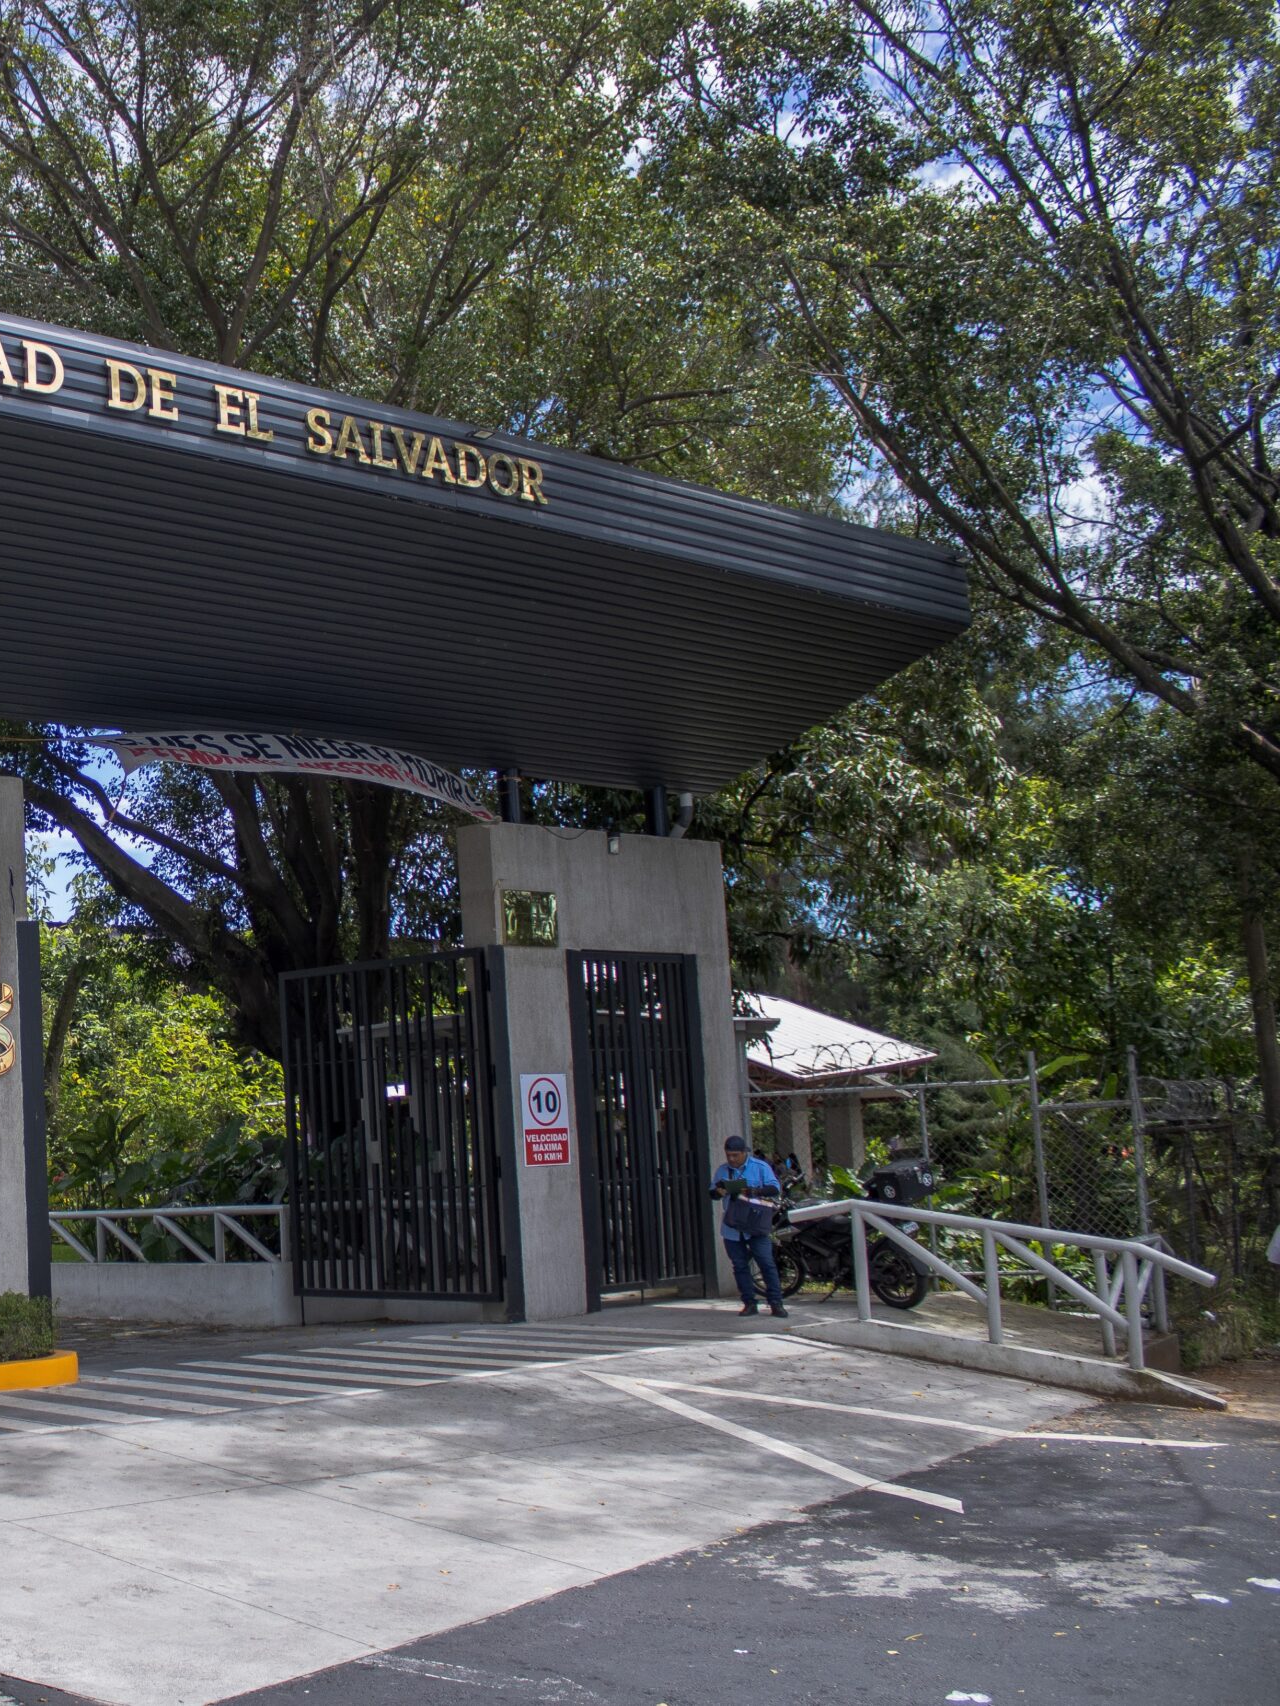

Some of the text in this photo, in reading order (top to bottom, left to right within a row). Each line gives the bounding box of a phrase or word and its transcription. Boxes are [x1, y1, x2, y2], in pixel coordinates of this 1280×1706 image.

[105, 359, 179, 422] DE
[214, 384, 274, 442] EL
[304, 408, 548, 505] SALVADOR
[224, 734, 282, 759] SE
[273, 735, 379, 761] NIEGA
[371, 746, 398, 765] A
[532, 1090, 558, 1113] 10
[526, 1133, 568, 1142] VELOCIDAD
[533, 1152, 563, 1161] 10 KM/H
